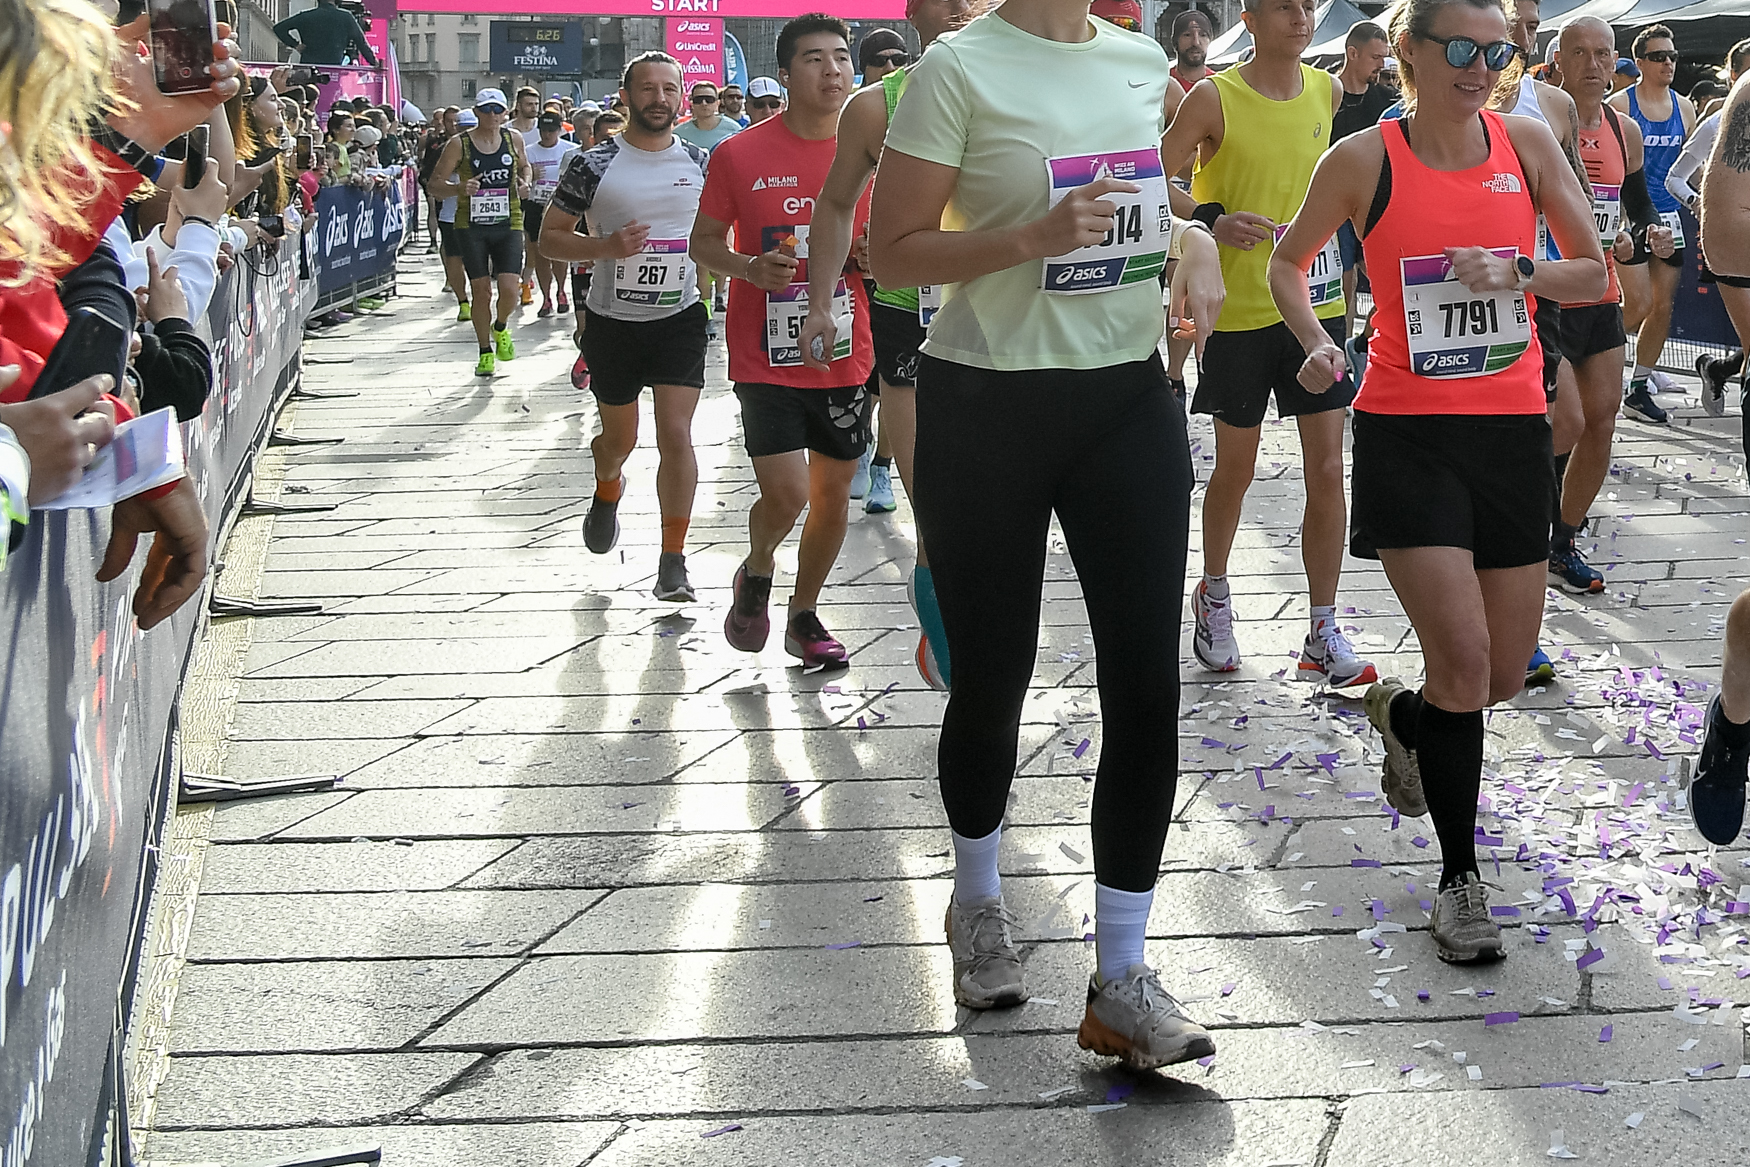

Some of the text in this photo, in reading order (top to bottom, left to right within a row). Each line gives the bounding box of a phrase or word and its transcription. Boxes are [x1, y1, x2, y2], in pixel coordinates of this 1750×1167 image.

[687, 22, 710, 31] asics
[684, 42, 716, 51] UniCredit
[514, 56, 558, 66] FESTINA
[683, 64, 715, 74] VISSIMA
[1482, 179, 1508, 188] NORTH
[479, 202, 501, 213] 2643
[782, 196, 816, 215] en
[637, 265, 668, 285] 267
[1073, 265, 1108, 281] asics
[630, 291, 649, 301] asics
[1438, 298, 1500, 339] 7791
[1437, 353, 1470, 367] asics
